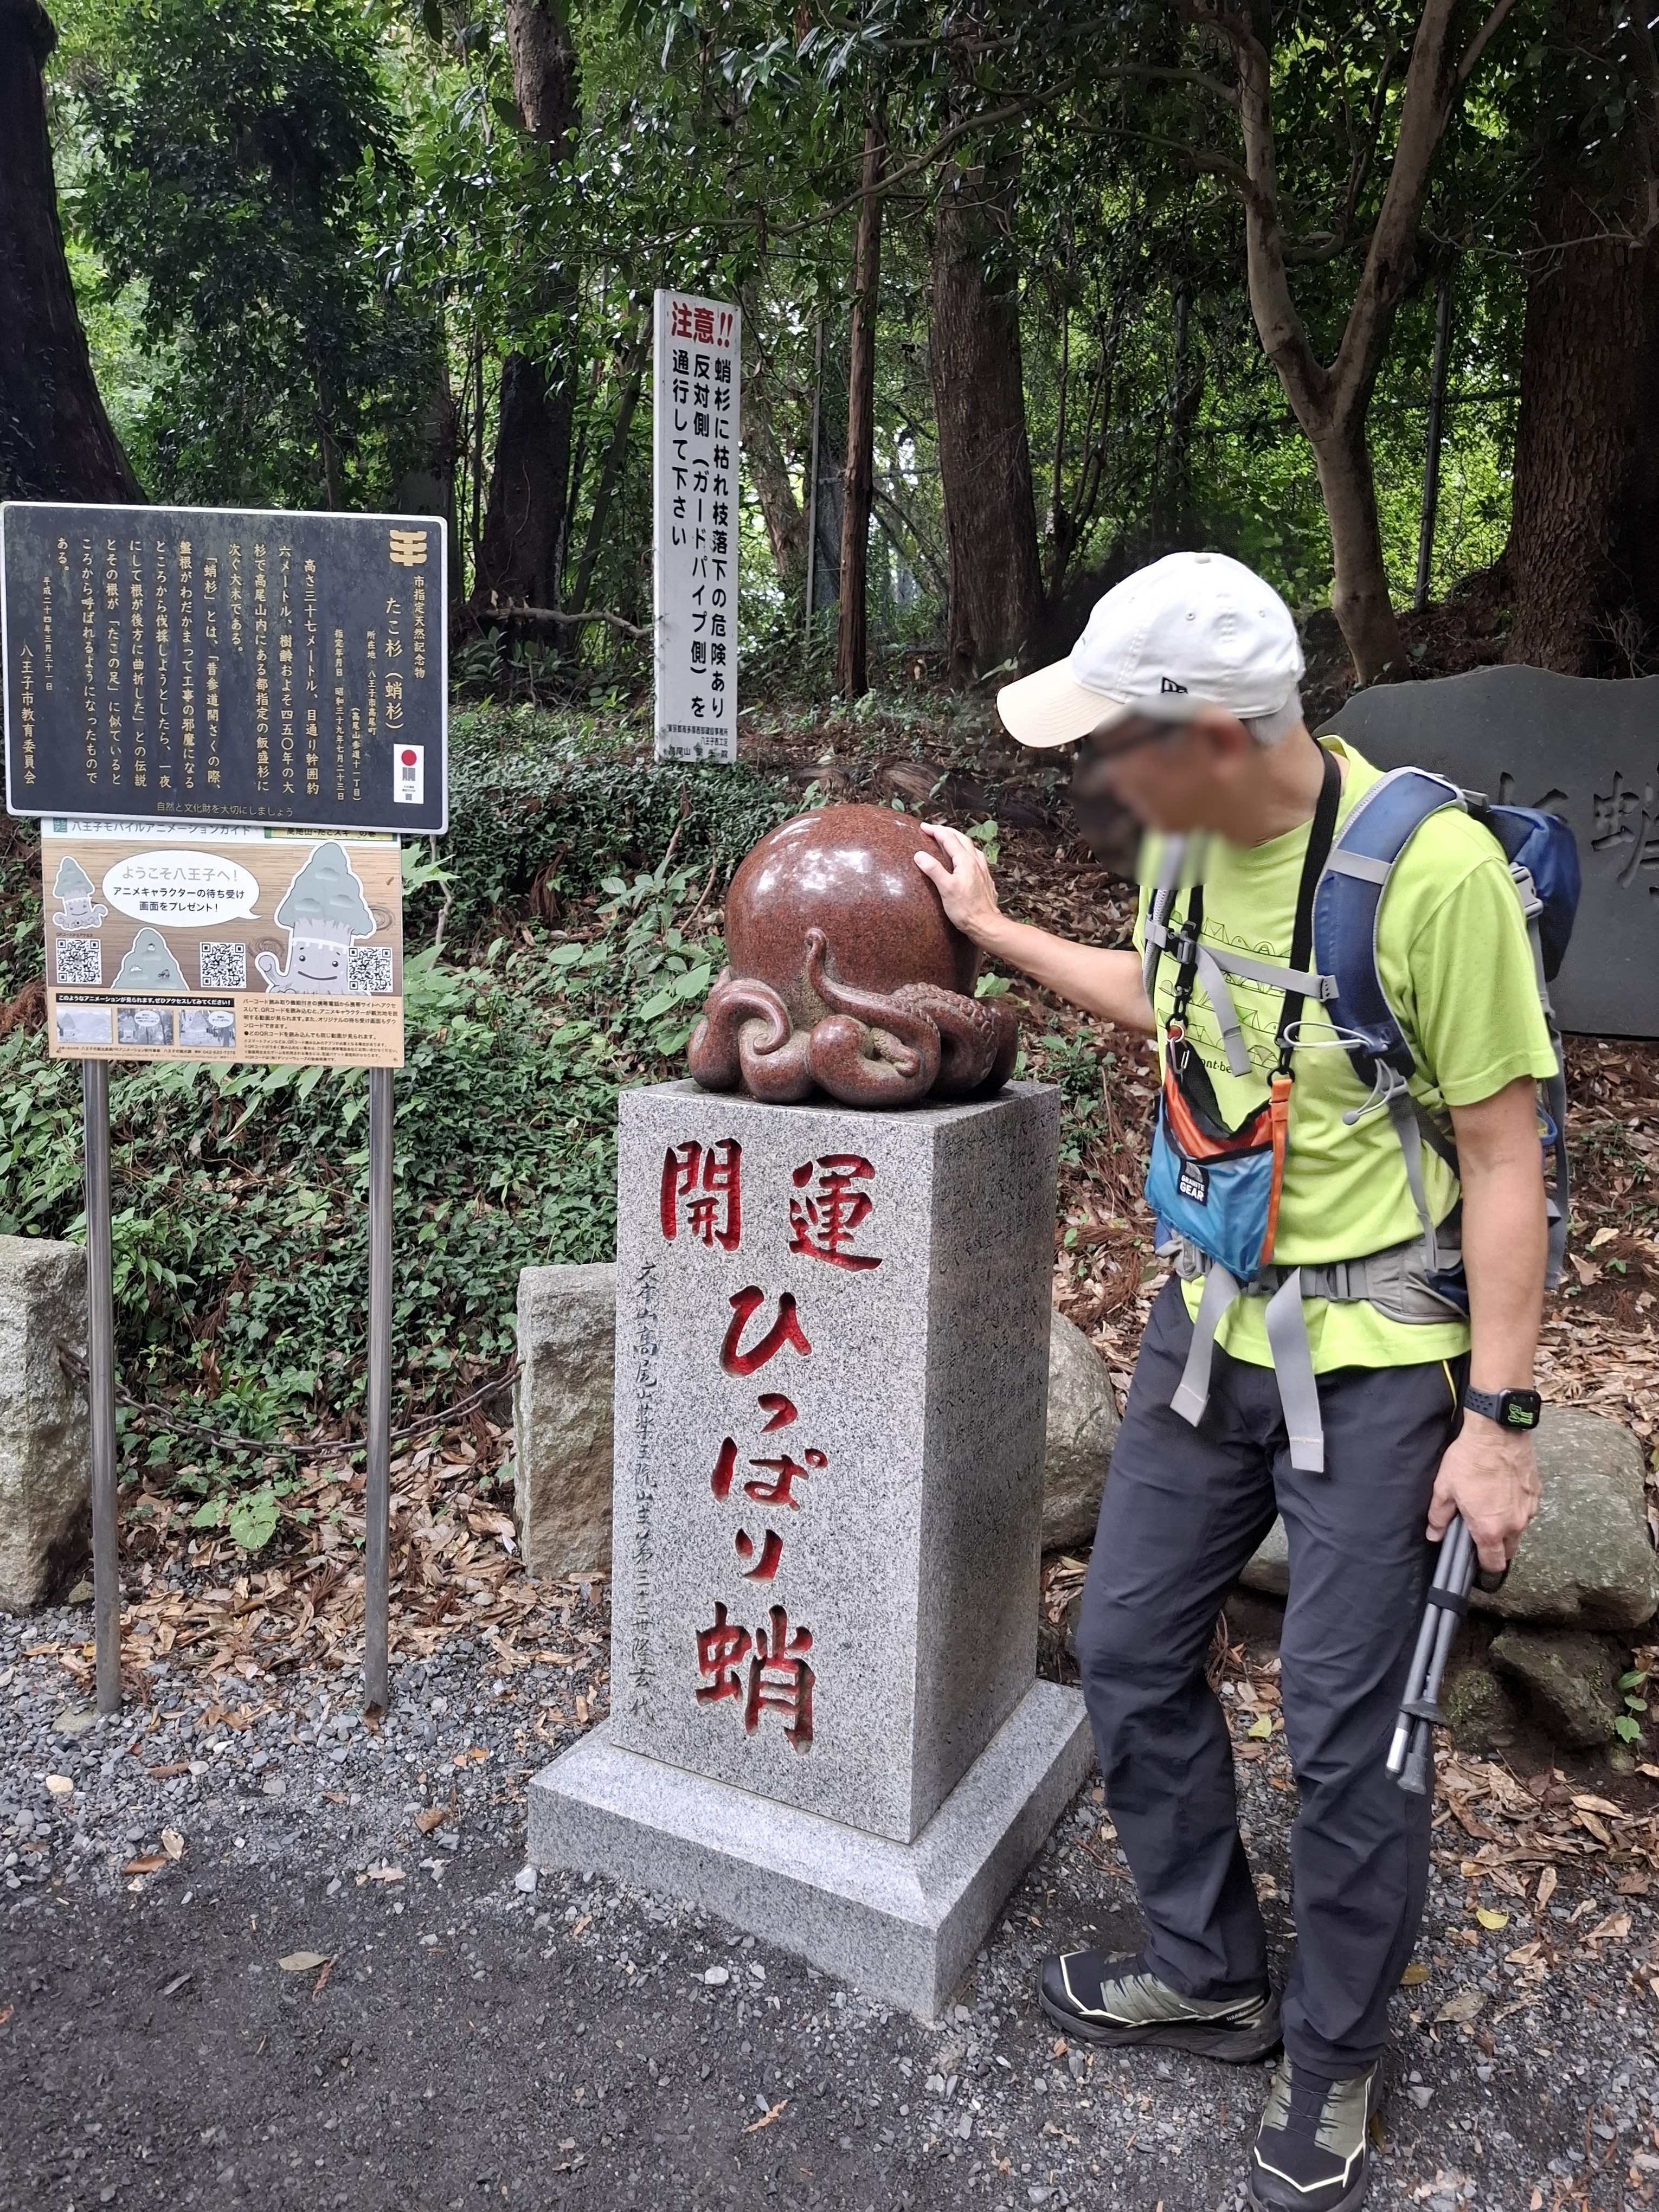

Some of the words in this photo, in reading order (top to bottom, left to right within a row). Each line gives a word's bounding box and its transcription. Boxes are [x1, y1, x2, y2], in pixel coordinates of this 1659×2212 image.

[671, 349, 690, 547] 通行して下さい
[56, 537, 70, 571] ある。
[710, 357, 731, 719] 蛸杉に枯れ枝落下の危険あり
[42, 576, 53, 691] 平成二十四年三月三十一日
[228, 544, 244, 652] 次ぐ大木である。
[366, 630, 376, 659] 所在地
[413, 575, 426, 679] 市指定天然記念物
[81, 538, 98, 785] ころから呼ばれるようになったもので
[155, 540, 172, 788] ところから伐採しようとしたら、一夜
[253, 544, 270, 792] 杉で高尾山内にある都指定の飯盛杉に
[303, 558, 320, 795] 高さ三十七メートル、目通り幹囲約
[334, 629, 344, 677] 指定年月日
[367, 670, 377, 736] 八王子市高尾町
[20, 644, 37, 786] 八王子市教育委員会
[335, 687, 345, 801] 昭和三十九年七月二十三日
[72, 821, 251, 835] 八王子モバイルアニメーションガイド
[157, 801, 293, 818] 自然と文化財を大切にしましょう
[113, 886, 245, 900] アニメキャラクターの待ち受け
[1180, 1181, 1205, 1203] GEAR
[1181, 1174, 1205, 1192] GRANITE
